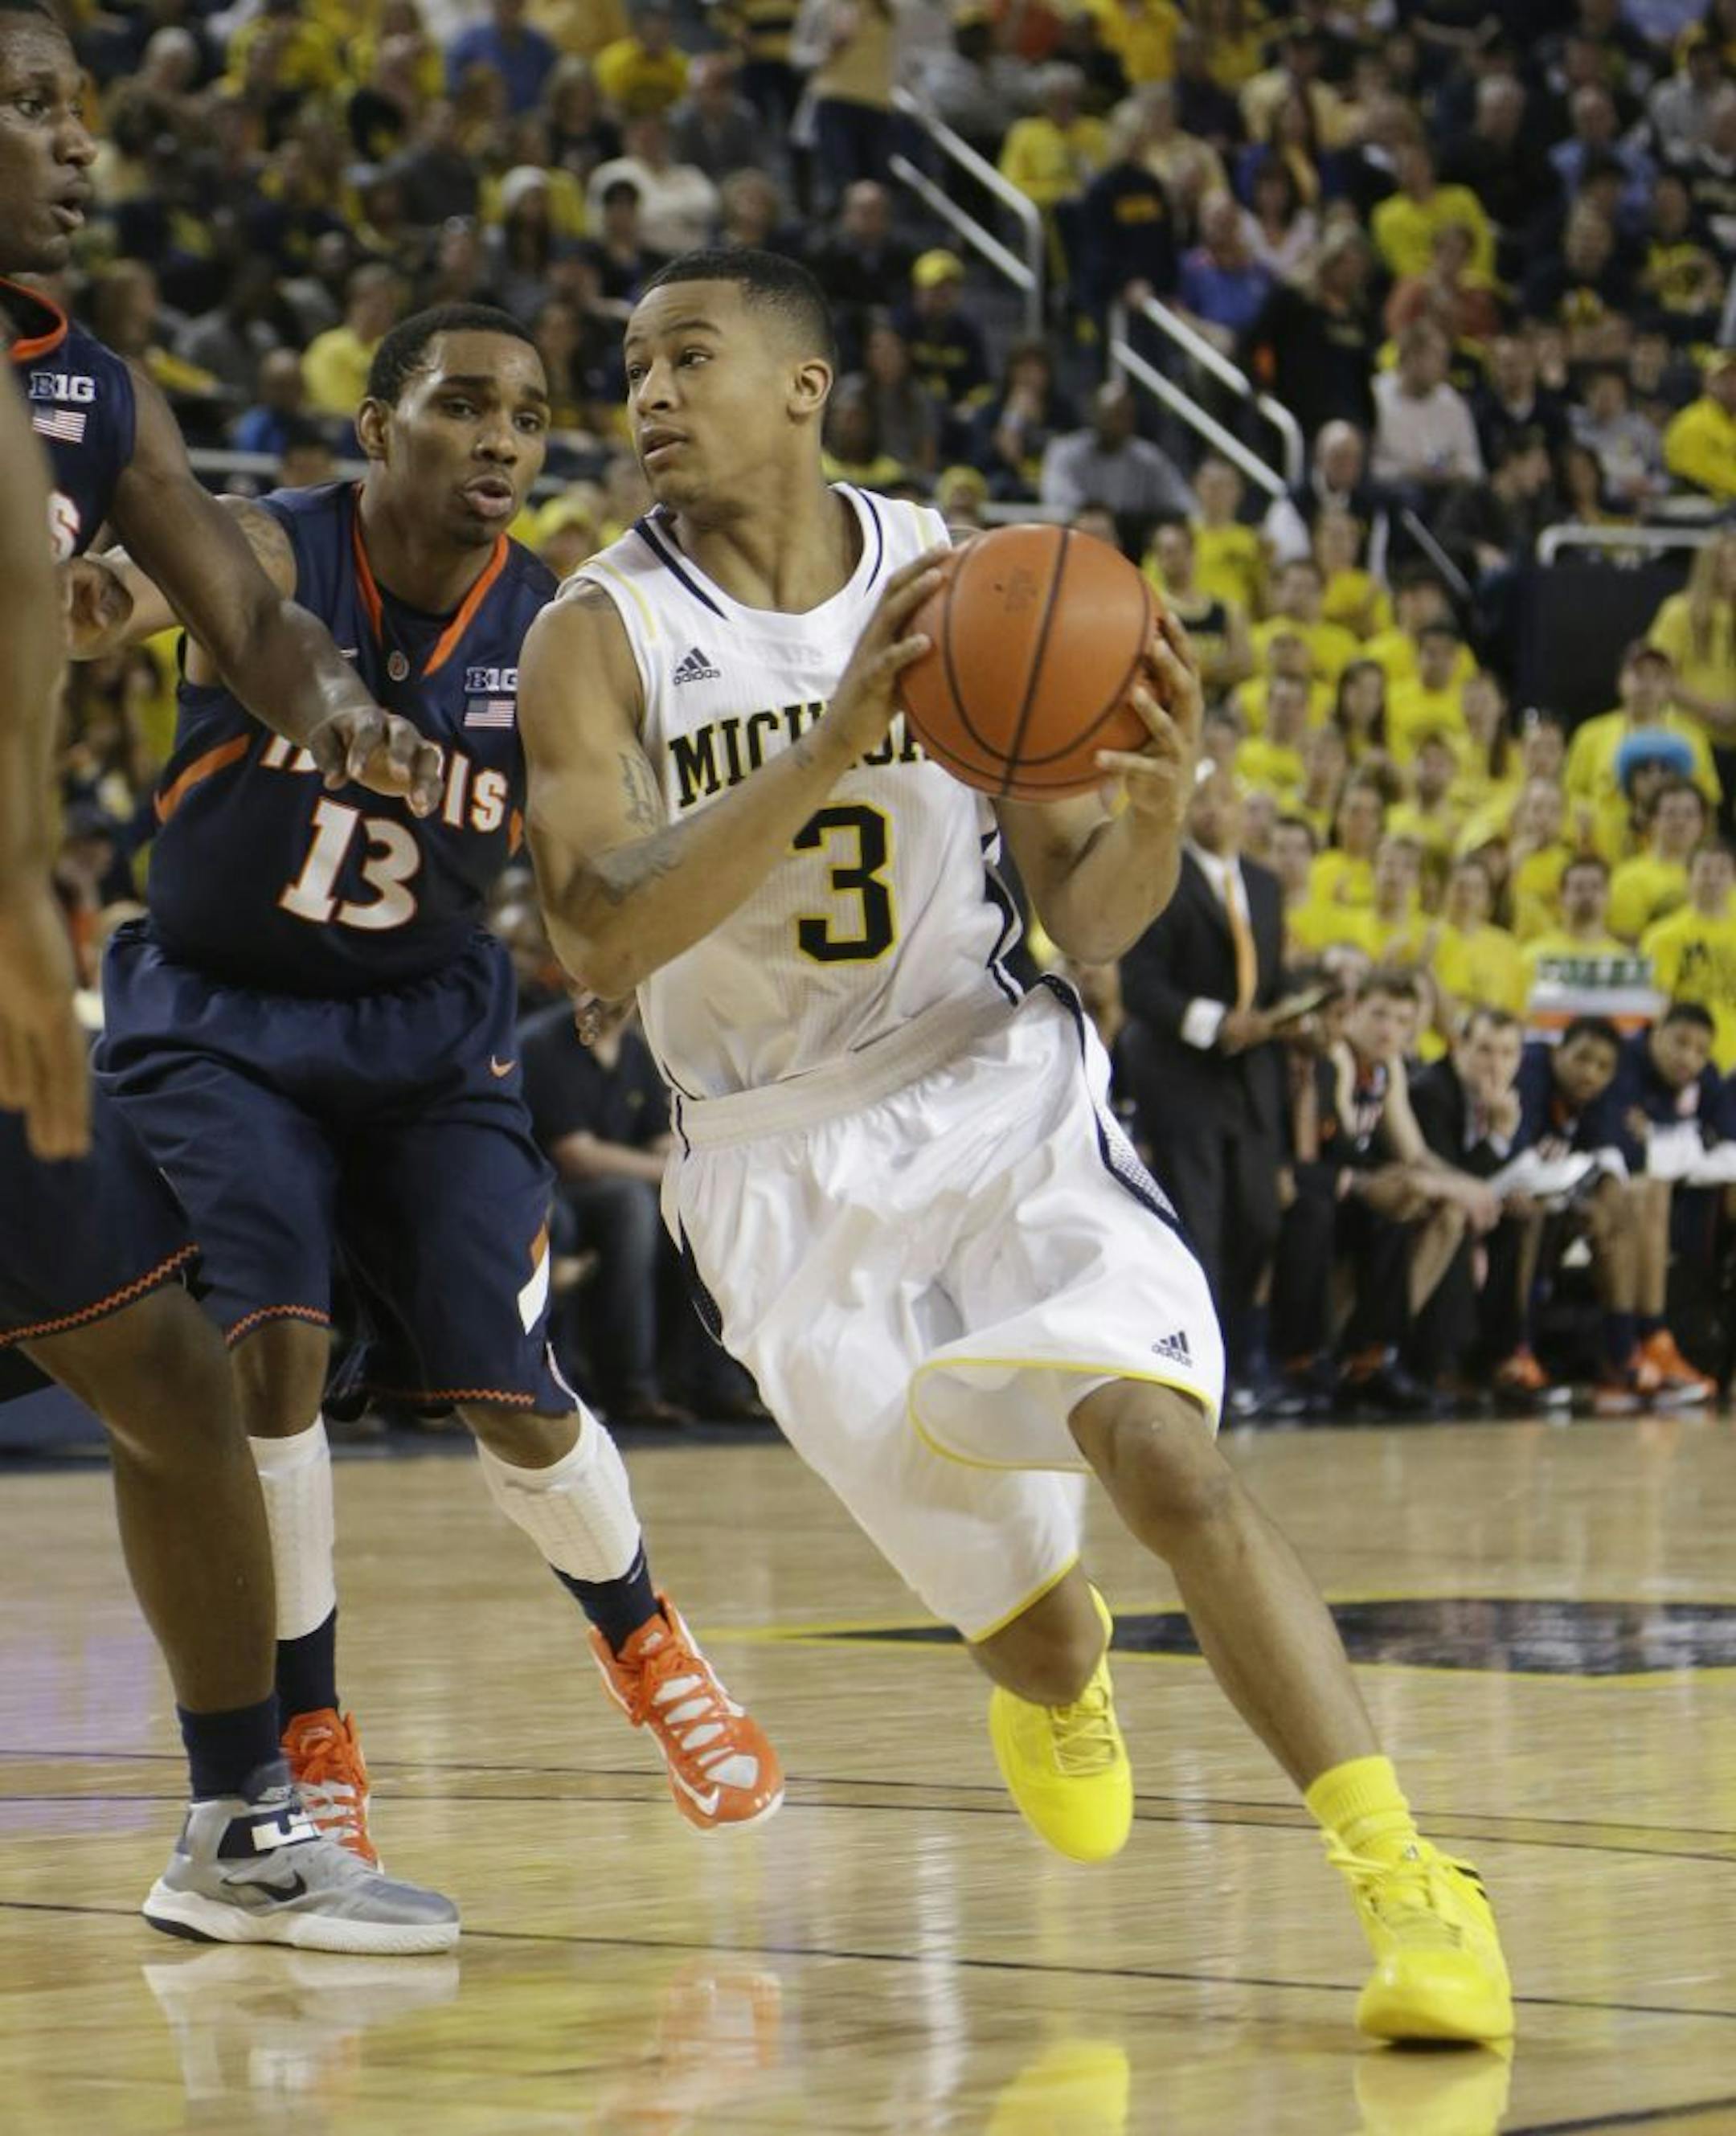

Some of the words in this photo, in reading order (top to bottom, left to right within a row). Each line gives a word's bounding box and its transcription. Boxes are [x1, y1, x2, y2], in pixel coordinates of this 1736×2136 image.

[674, 667, 720, 685] adidas
[277, 796, 422, 931] 13
[791, 802, 897, 964] 3
